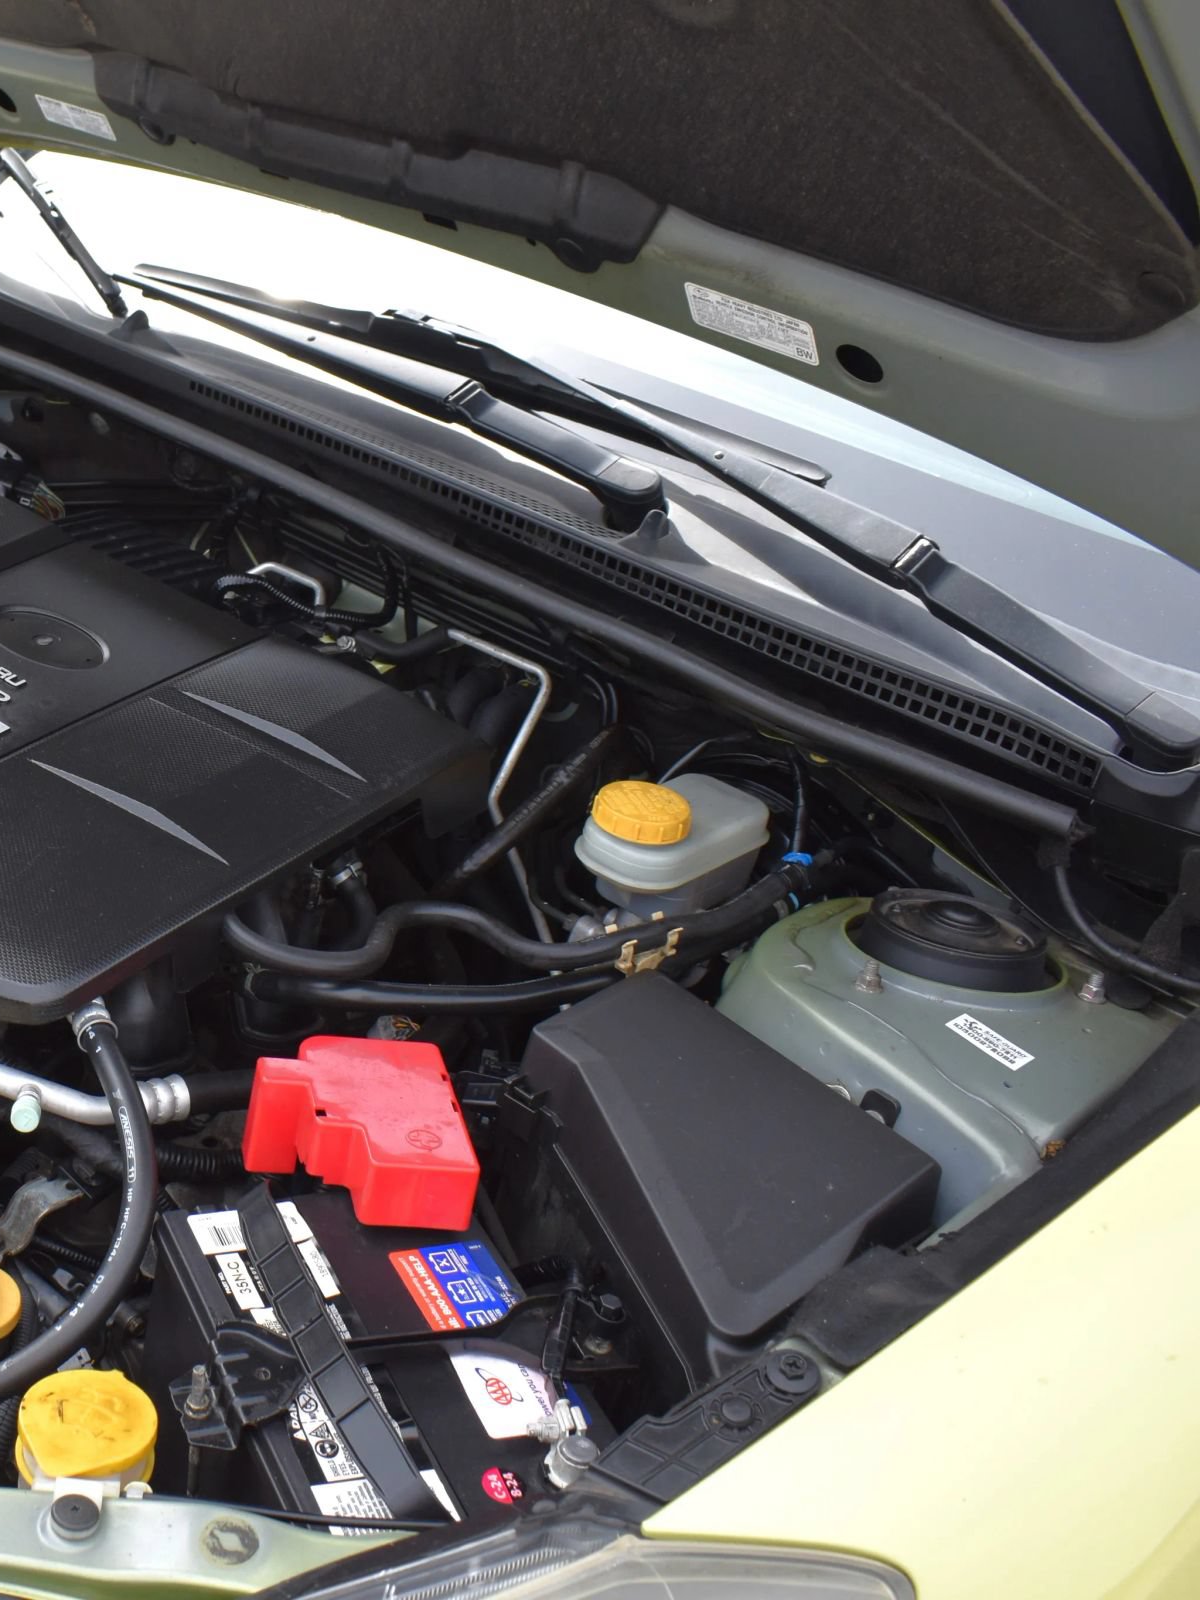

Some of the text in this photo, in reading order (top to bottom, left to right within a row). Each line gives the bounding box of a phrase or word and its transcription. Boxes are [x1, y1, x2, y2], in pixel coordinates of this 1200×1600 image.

[796, 347, 813, 360] BW
[227, 1261, 252, 1295] 35N-C
[408, 1255, 452, 1315] 800-AAA-HELP
[488, 1379, 511, 1404] AAA
[527, 1378, 540, 1396] you
[486, 1474, 506, 1499] C-24
[503, 1472, 523, 1497] 8-24
